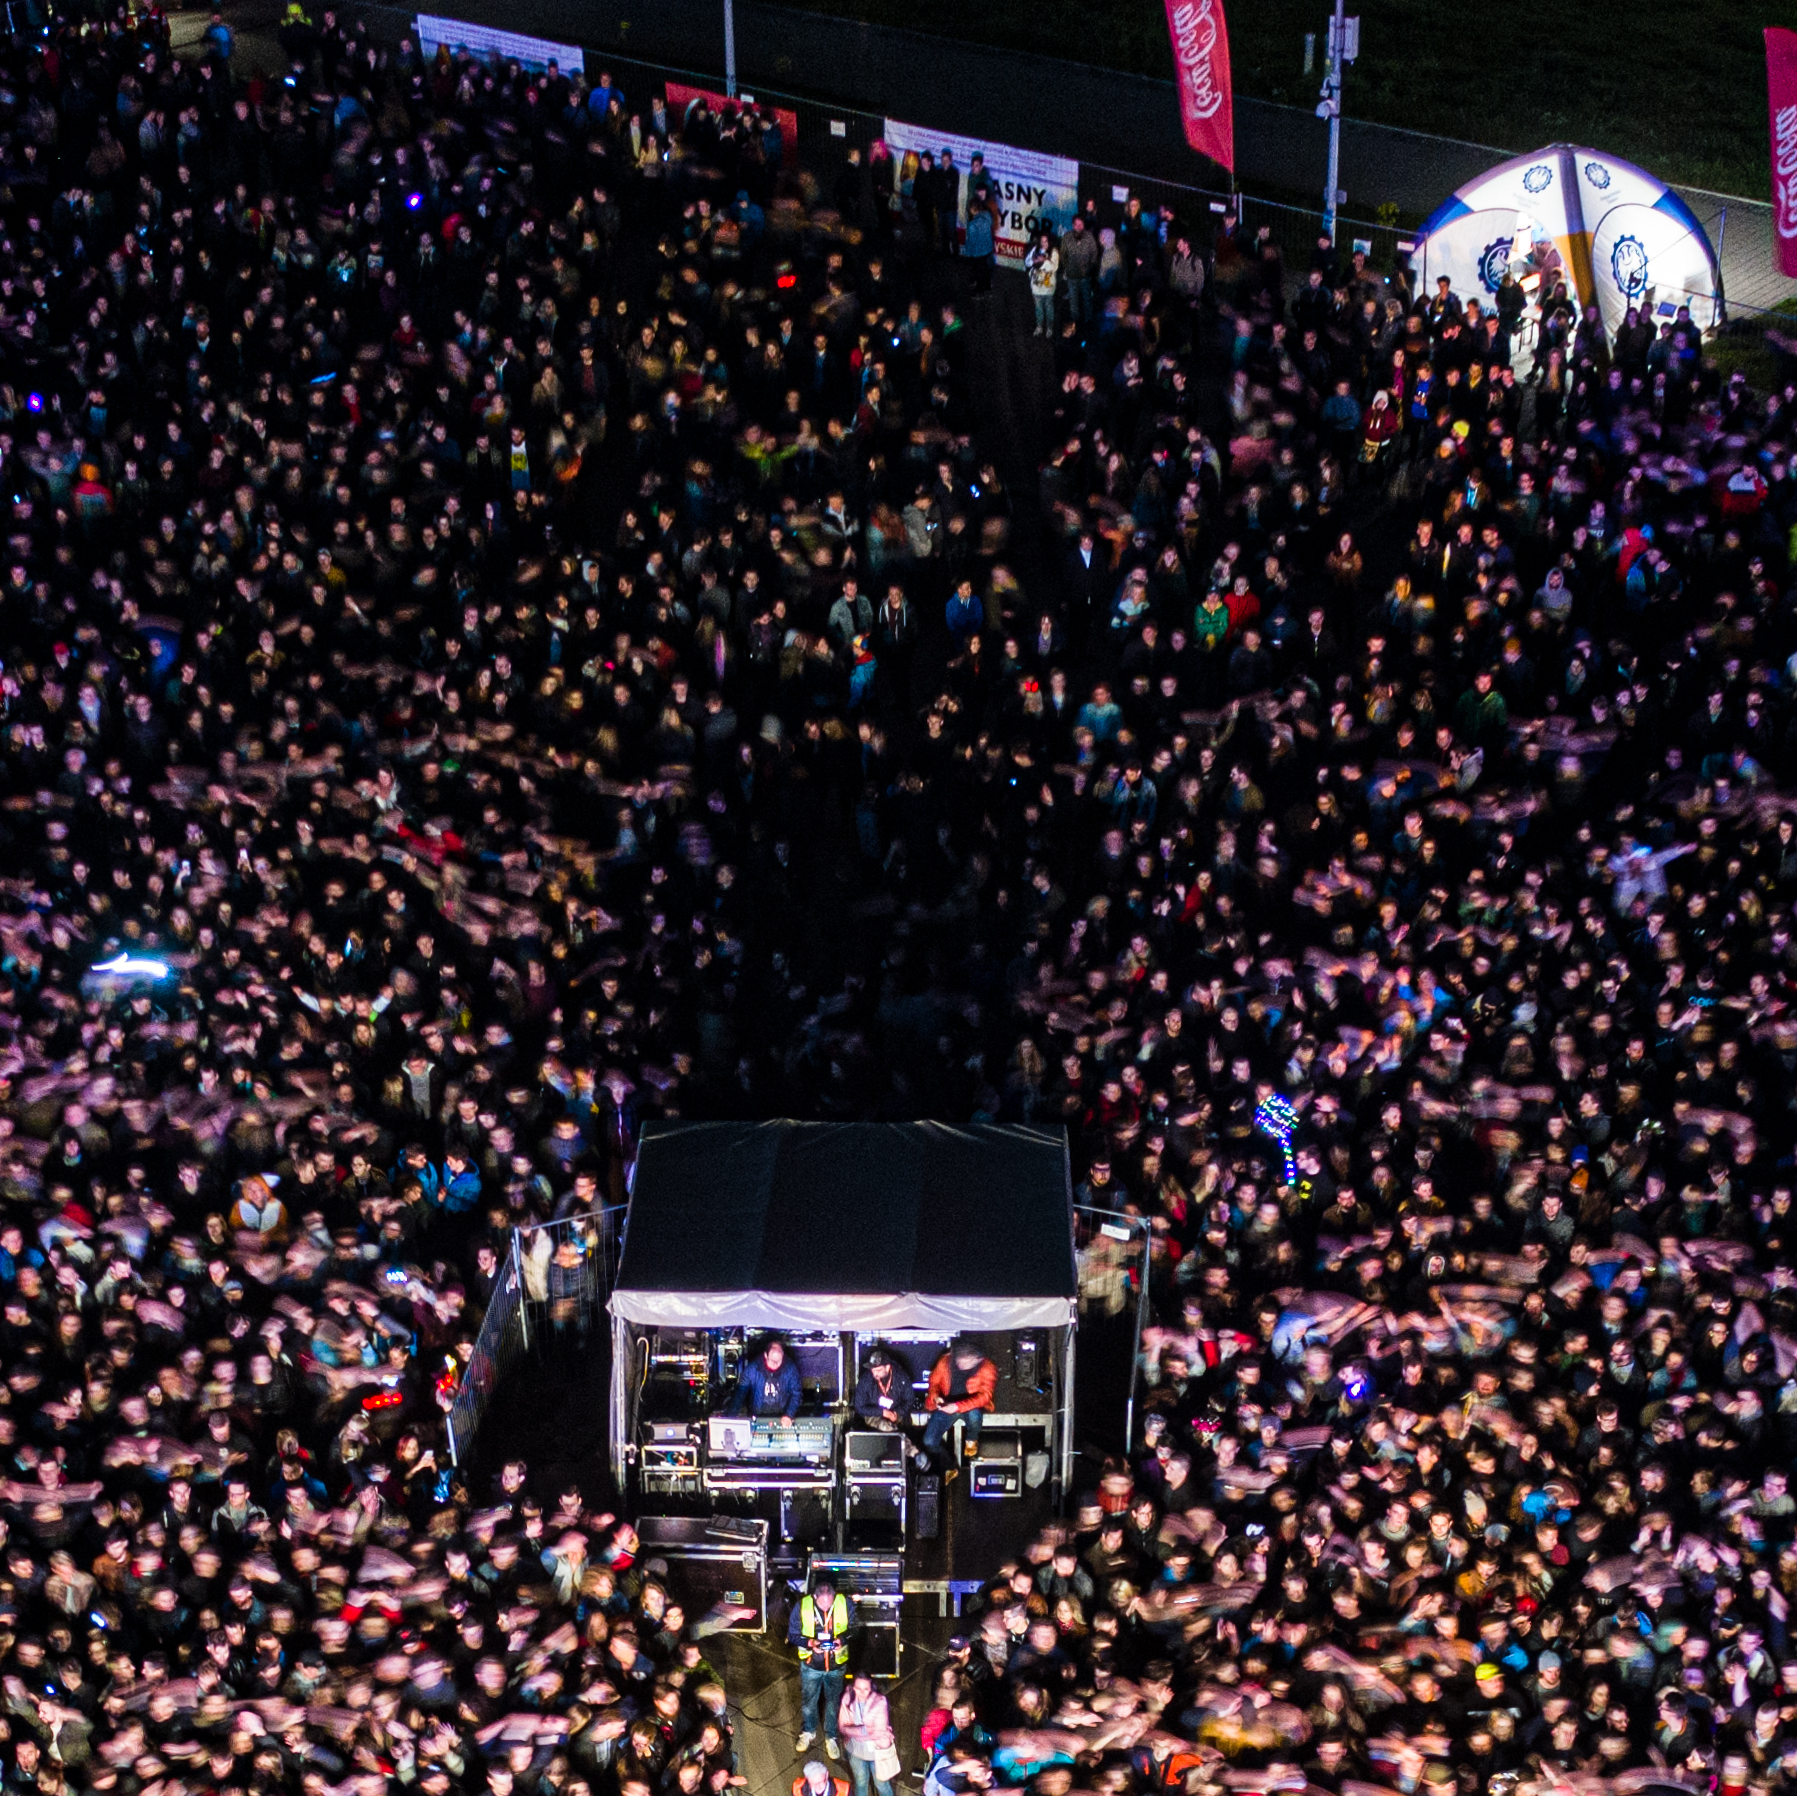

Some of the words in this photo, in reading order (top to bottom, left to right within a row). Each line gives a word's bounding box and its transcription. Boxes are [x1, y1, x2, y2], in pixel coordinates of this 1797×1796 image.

[993, 179, 1046, 207] ASNY
[999, 206, 1052, 235] YBÓR
[994, 242, 1024, 258] YSKIE
